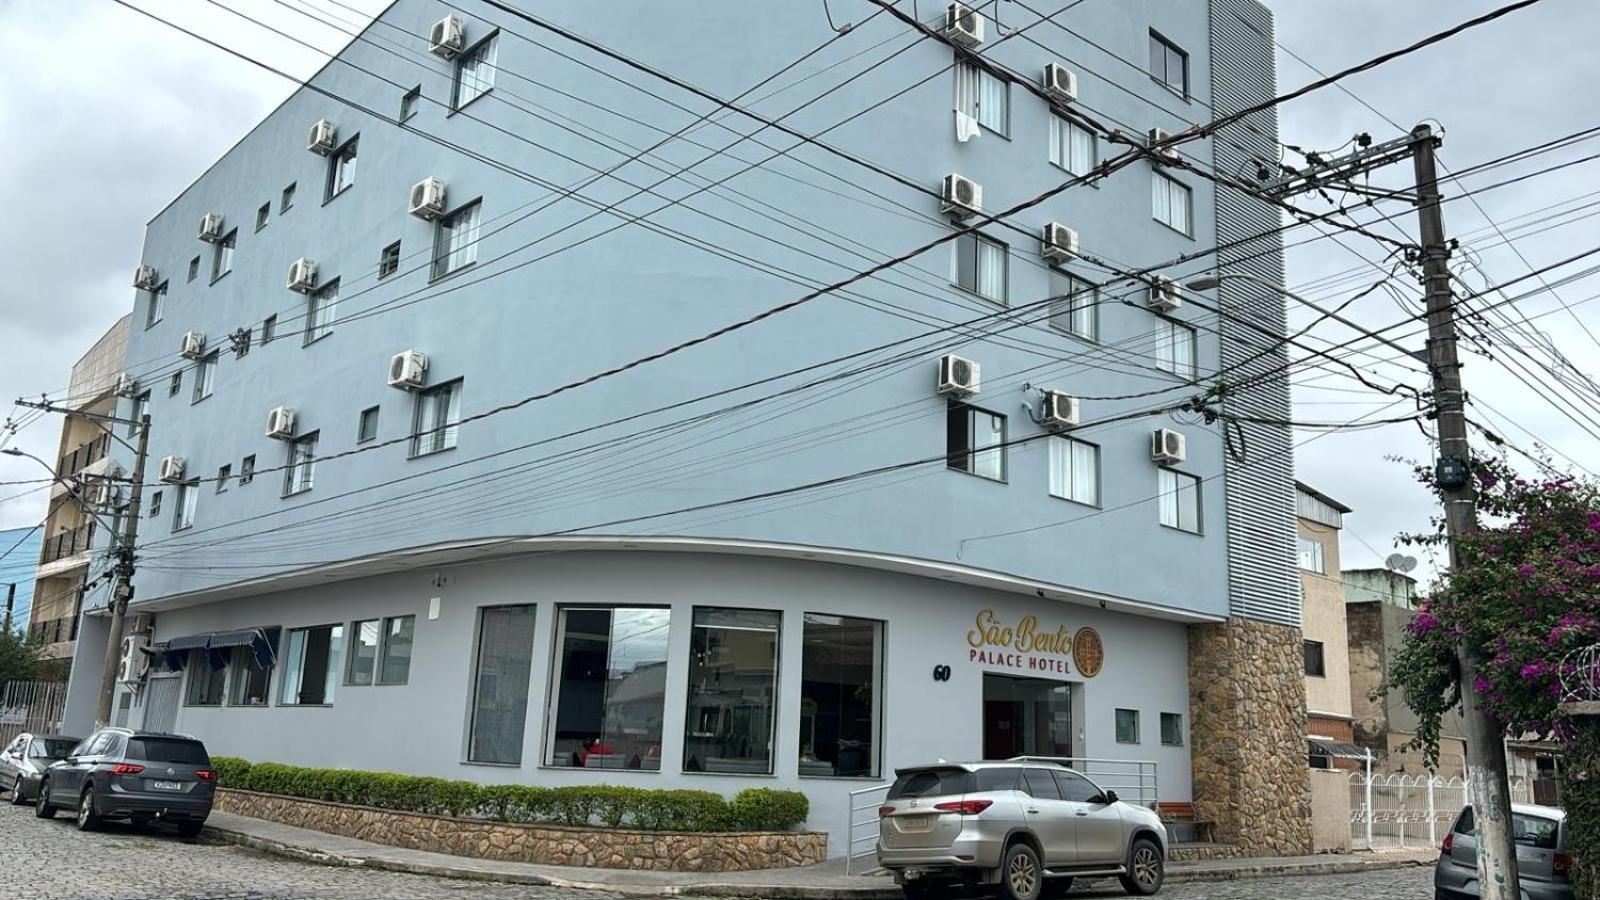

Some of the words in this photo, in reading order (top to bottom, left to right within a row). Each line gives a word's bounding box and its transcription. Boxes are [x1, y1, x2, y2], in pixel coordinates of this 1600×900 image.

[967, 608, 1012, 647] São
[1015, 615, 1072, 654] Bento
[933, 664, 951, 681] 60
[970, 649, 1022, 667] PALACE
[1029, 657, 1070, 674] HOTEL
